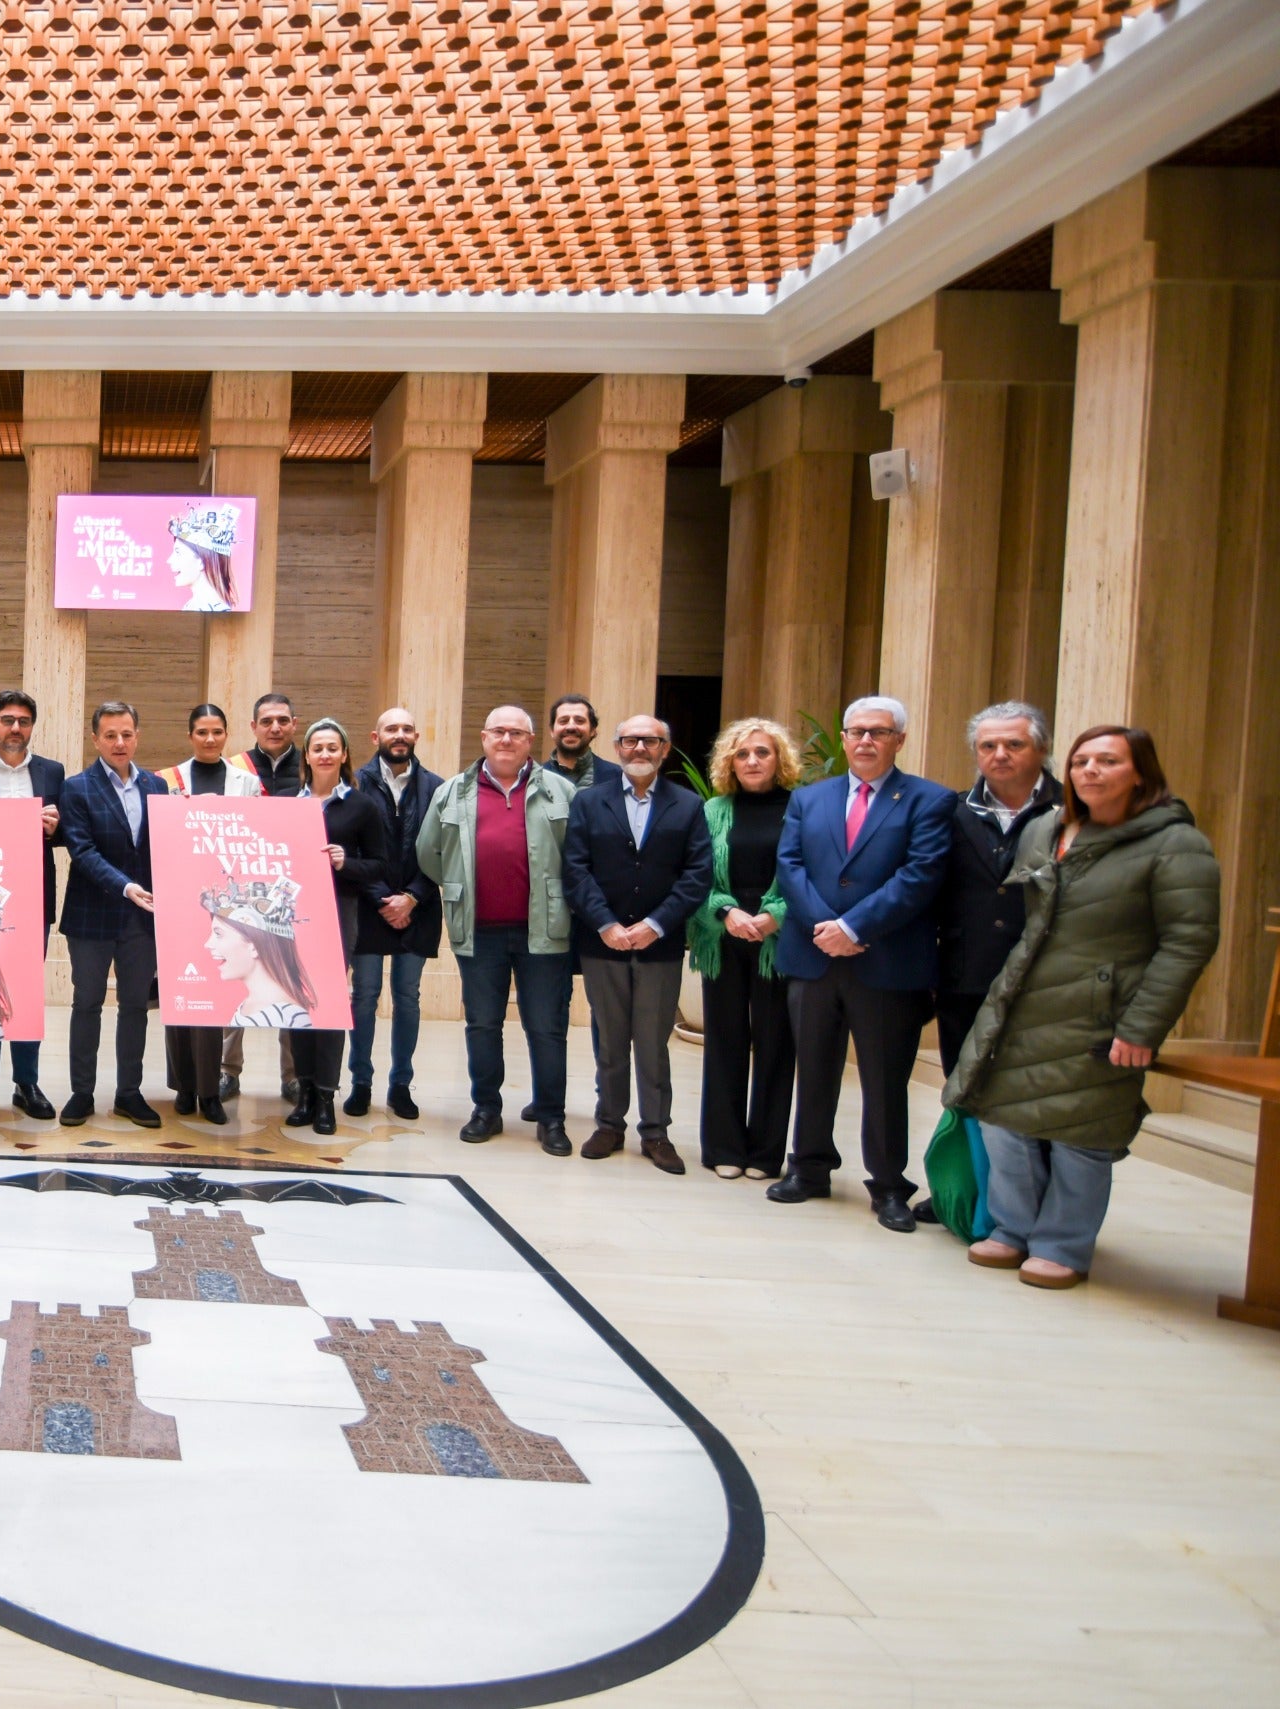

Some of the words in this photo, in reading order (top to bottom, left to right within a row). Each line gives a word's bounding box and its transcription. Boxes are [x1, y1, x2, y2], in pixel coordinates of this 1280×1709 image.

[86, 526, 130, 542] Vida,
[77, 540, 153, 558] ¡Mucha
[95, 557, 153, 576] Vida!
[185, 811, 244, 821] Albacete
[185, 821, 199, 829] es
[200, 822, 258, 840] Vida,
[192, 837, 289, 856] ¡Mucha
[217, 855, 292, 876] Vida!
